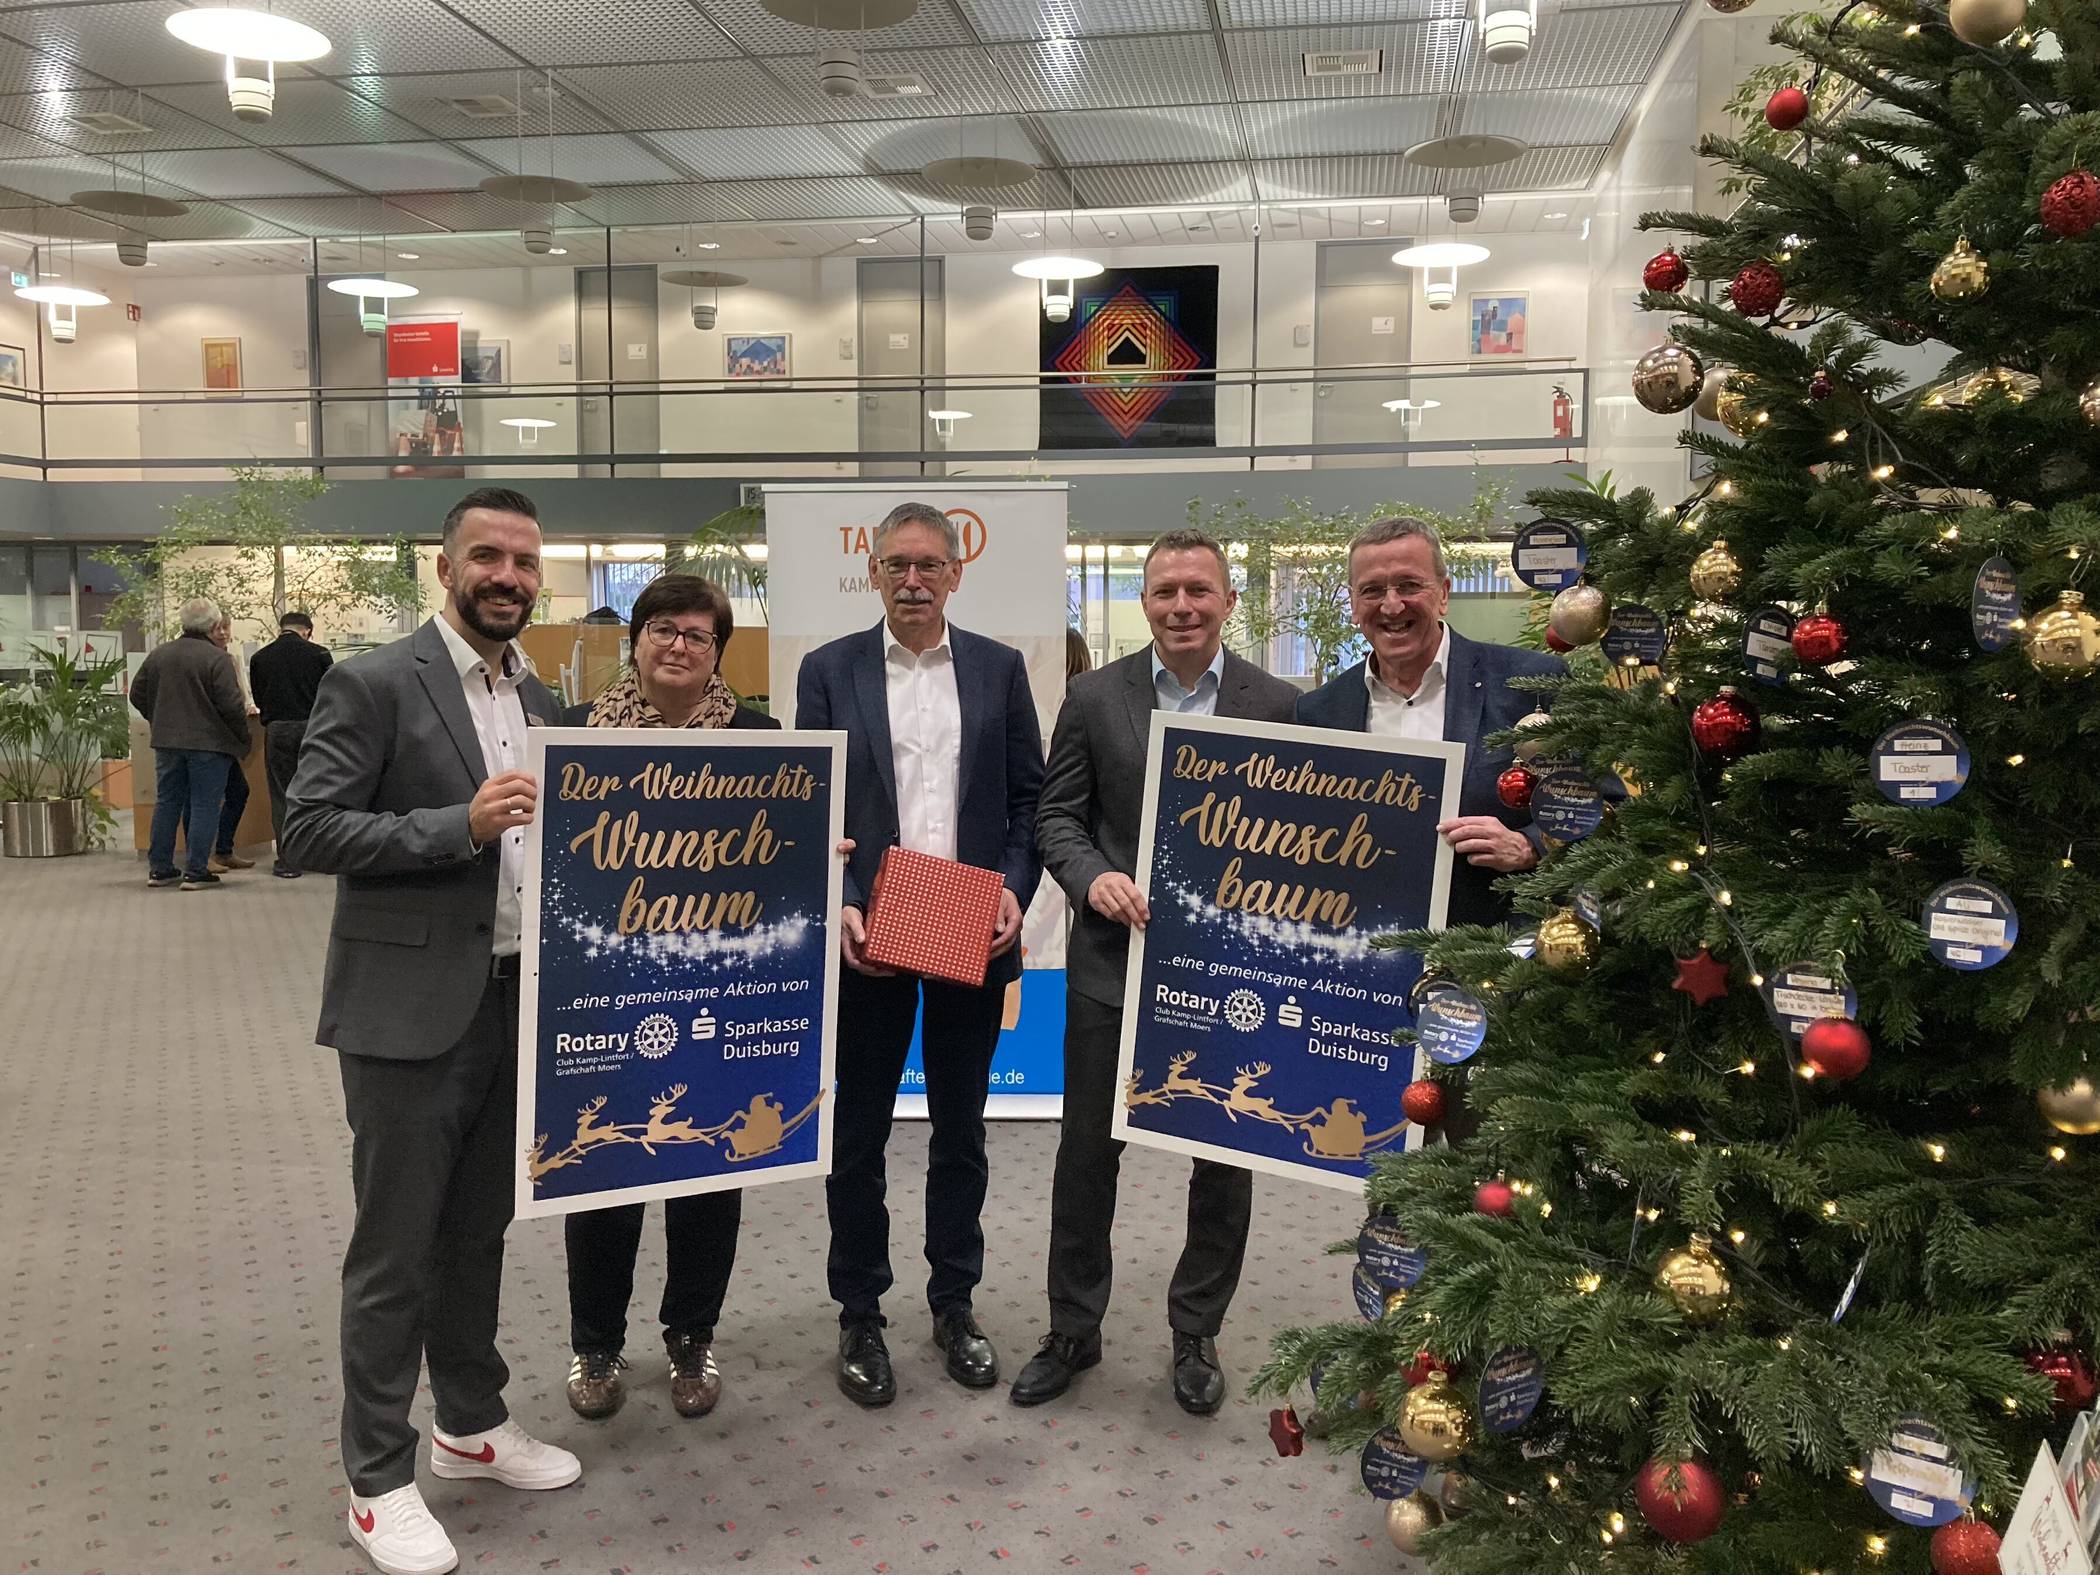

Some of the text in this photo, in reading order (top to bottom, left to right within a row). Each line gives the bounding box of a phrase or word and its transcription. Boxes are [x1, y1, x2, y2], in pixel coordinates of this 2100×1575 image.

[559, 761, 826, 801] Der Weihnachts-
[1173, 744, 1437, 813] Der Weihnachts-
[569, 808, 796, 872] Wunsch-
[1179, 792, 1397, 869] Wunsch-
[617, 875, 763, 935] baum
[1215, 855, 1358, 928] baum
[556, 979, 809, 1011] ...eine gemeinsame Aktion von
[1158, 953, 1403, 1007] ...eine gemeinsame Aktion von
[1154, 1006, 1170, 1015] Club
[1171, 1009, 1219, 1025] Kamp-Lintfort
[1155, 983, 1220, 1016] Rotary
[725, 1017, 809, 1040] Sparkasse
[1154, 1015, 1211, 1032] Grafschaft Moers
[556, 1032, 629, 1054] Rotary
[723, 1040, 800, 1060] Duisburg
[1308, 1037, 1388, 1072] Duisburg
[556, 1057, 575, 1068] Club
[576, 1053, 629, 1066] Kamp-Lintfort
[556, 1063, 622, 1077] Grafschaft Moers
